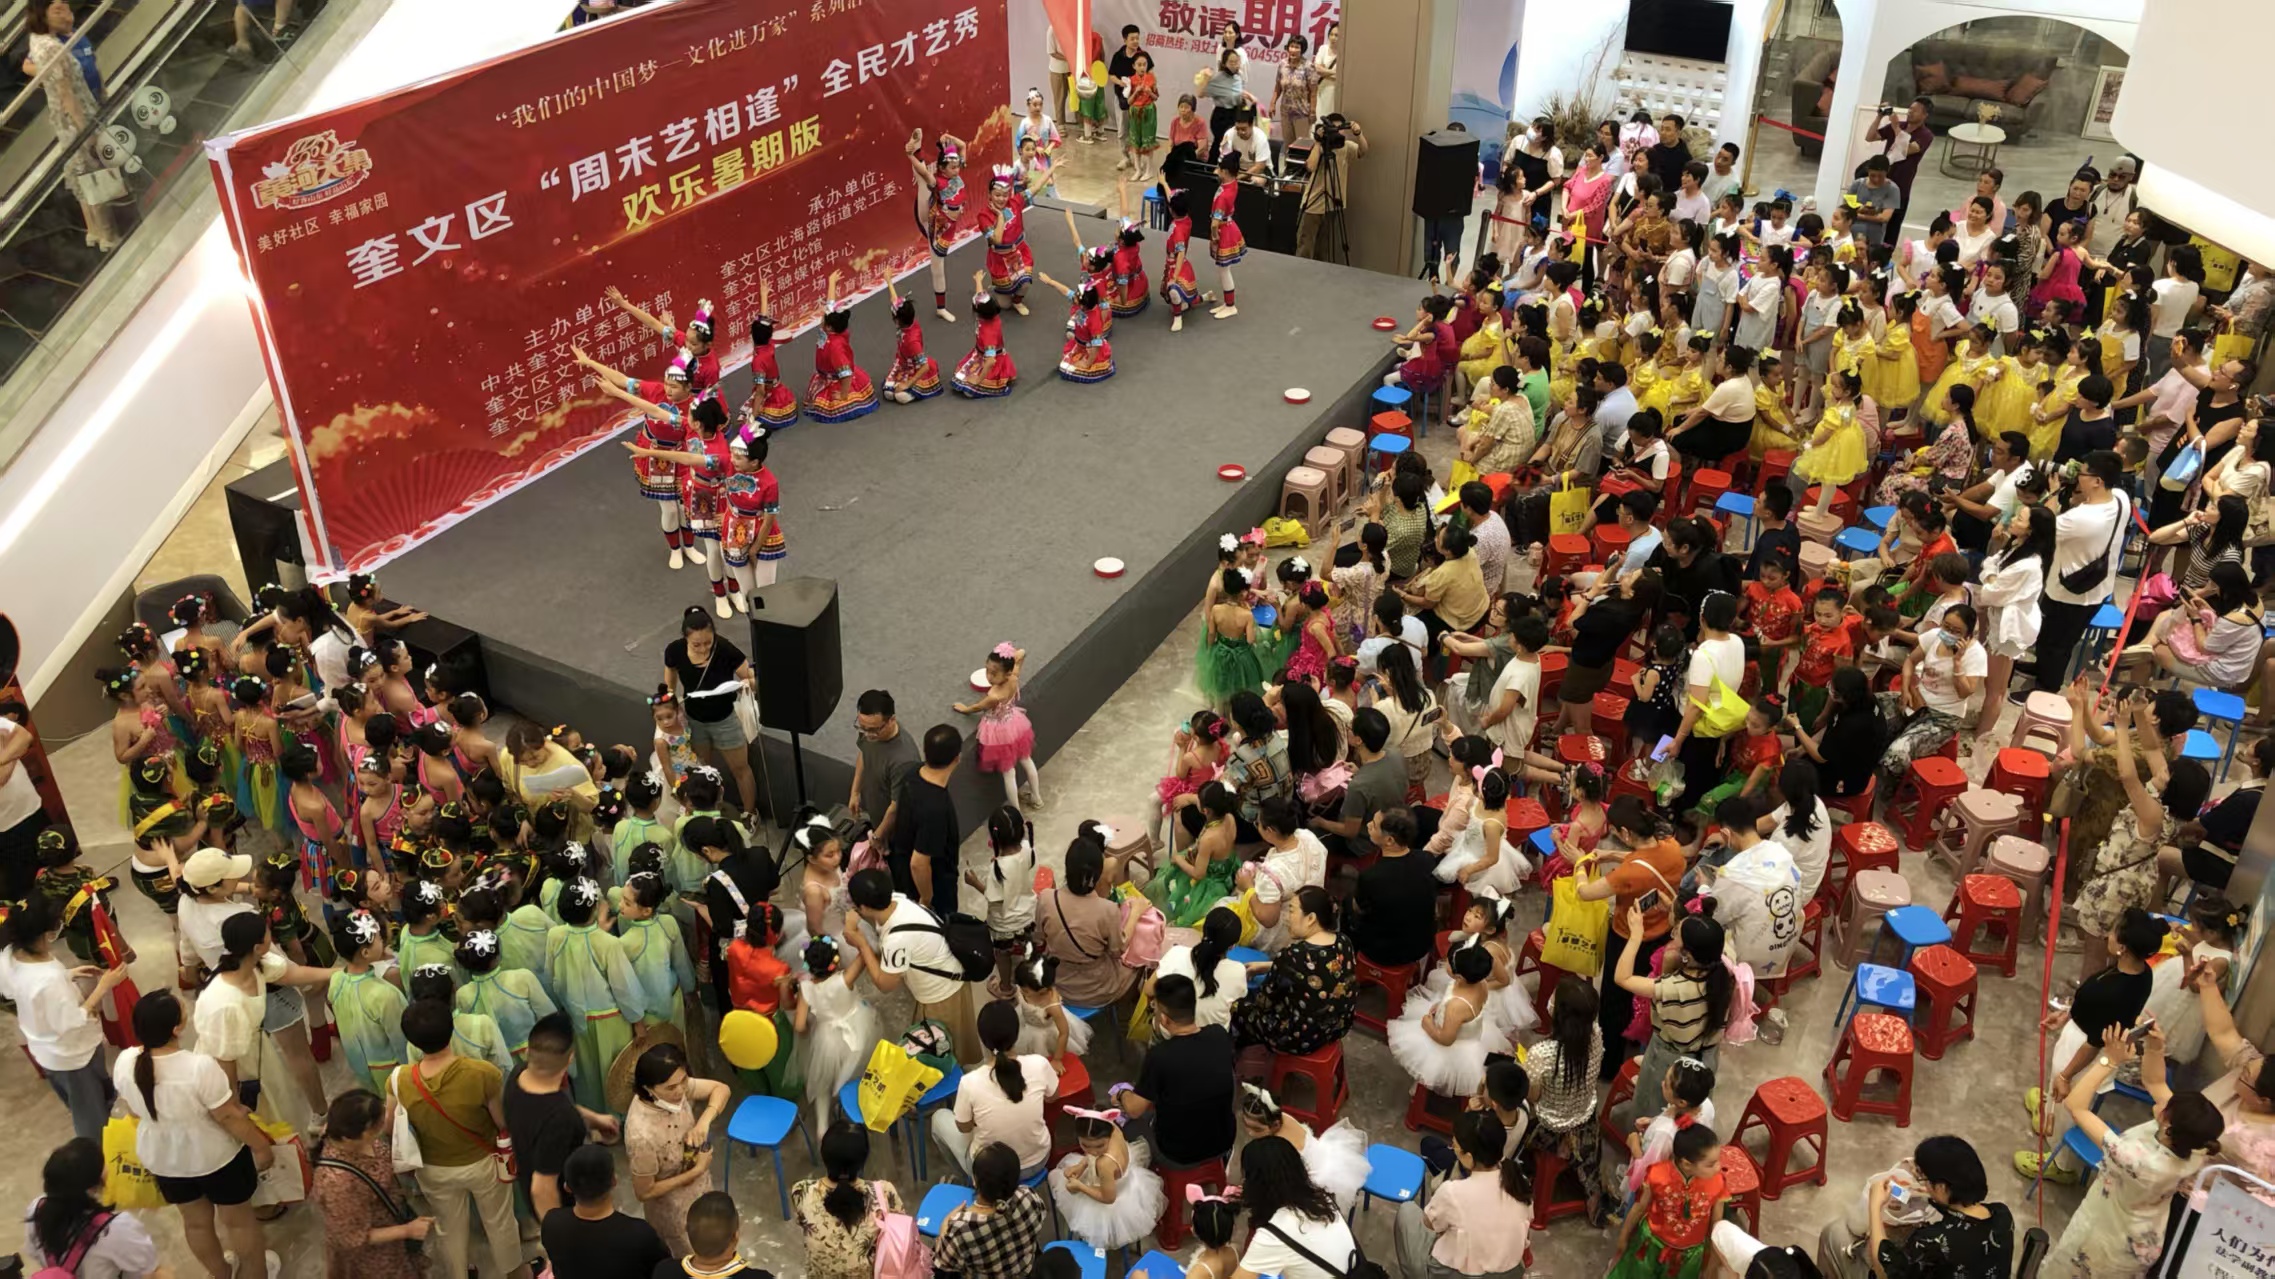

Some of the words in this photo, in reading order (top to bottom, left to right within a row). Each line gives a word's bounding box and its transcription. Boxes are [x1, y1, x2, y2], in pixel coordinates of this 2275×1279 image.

[345, 190, 514, 290] 奎文区
[540, 74, 799, 203] “周末艺相逢”
[820, 6, 979, 98] 全民才艺秀
[622, 114, 823, 231] 欢乐暑期版
[257, 217, 321, 254] 美好社区
[328, 191, 389, 226] 幸福家园
[720, 160, 938, 280] 奎文区北海路街道党工委、
[808, 170, 885, 216] 承办单位：
[722, 238, 824, 299] 奎文区文化馆
[485, 309, 675, 417] 奎文区文和旅游
[2215, 1245, 2275, 1279] 法学副教
